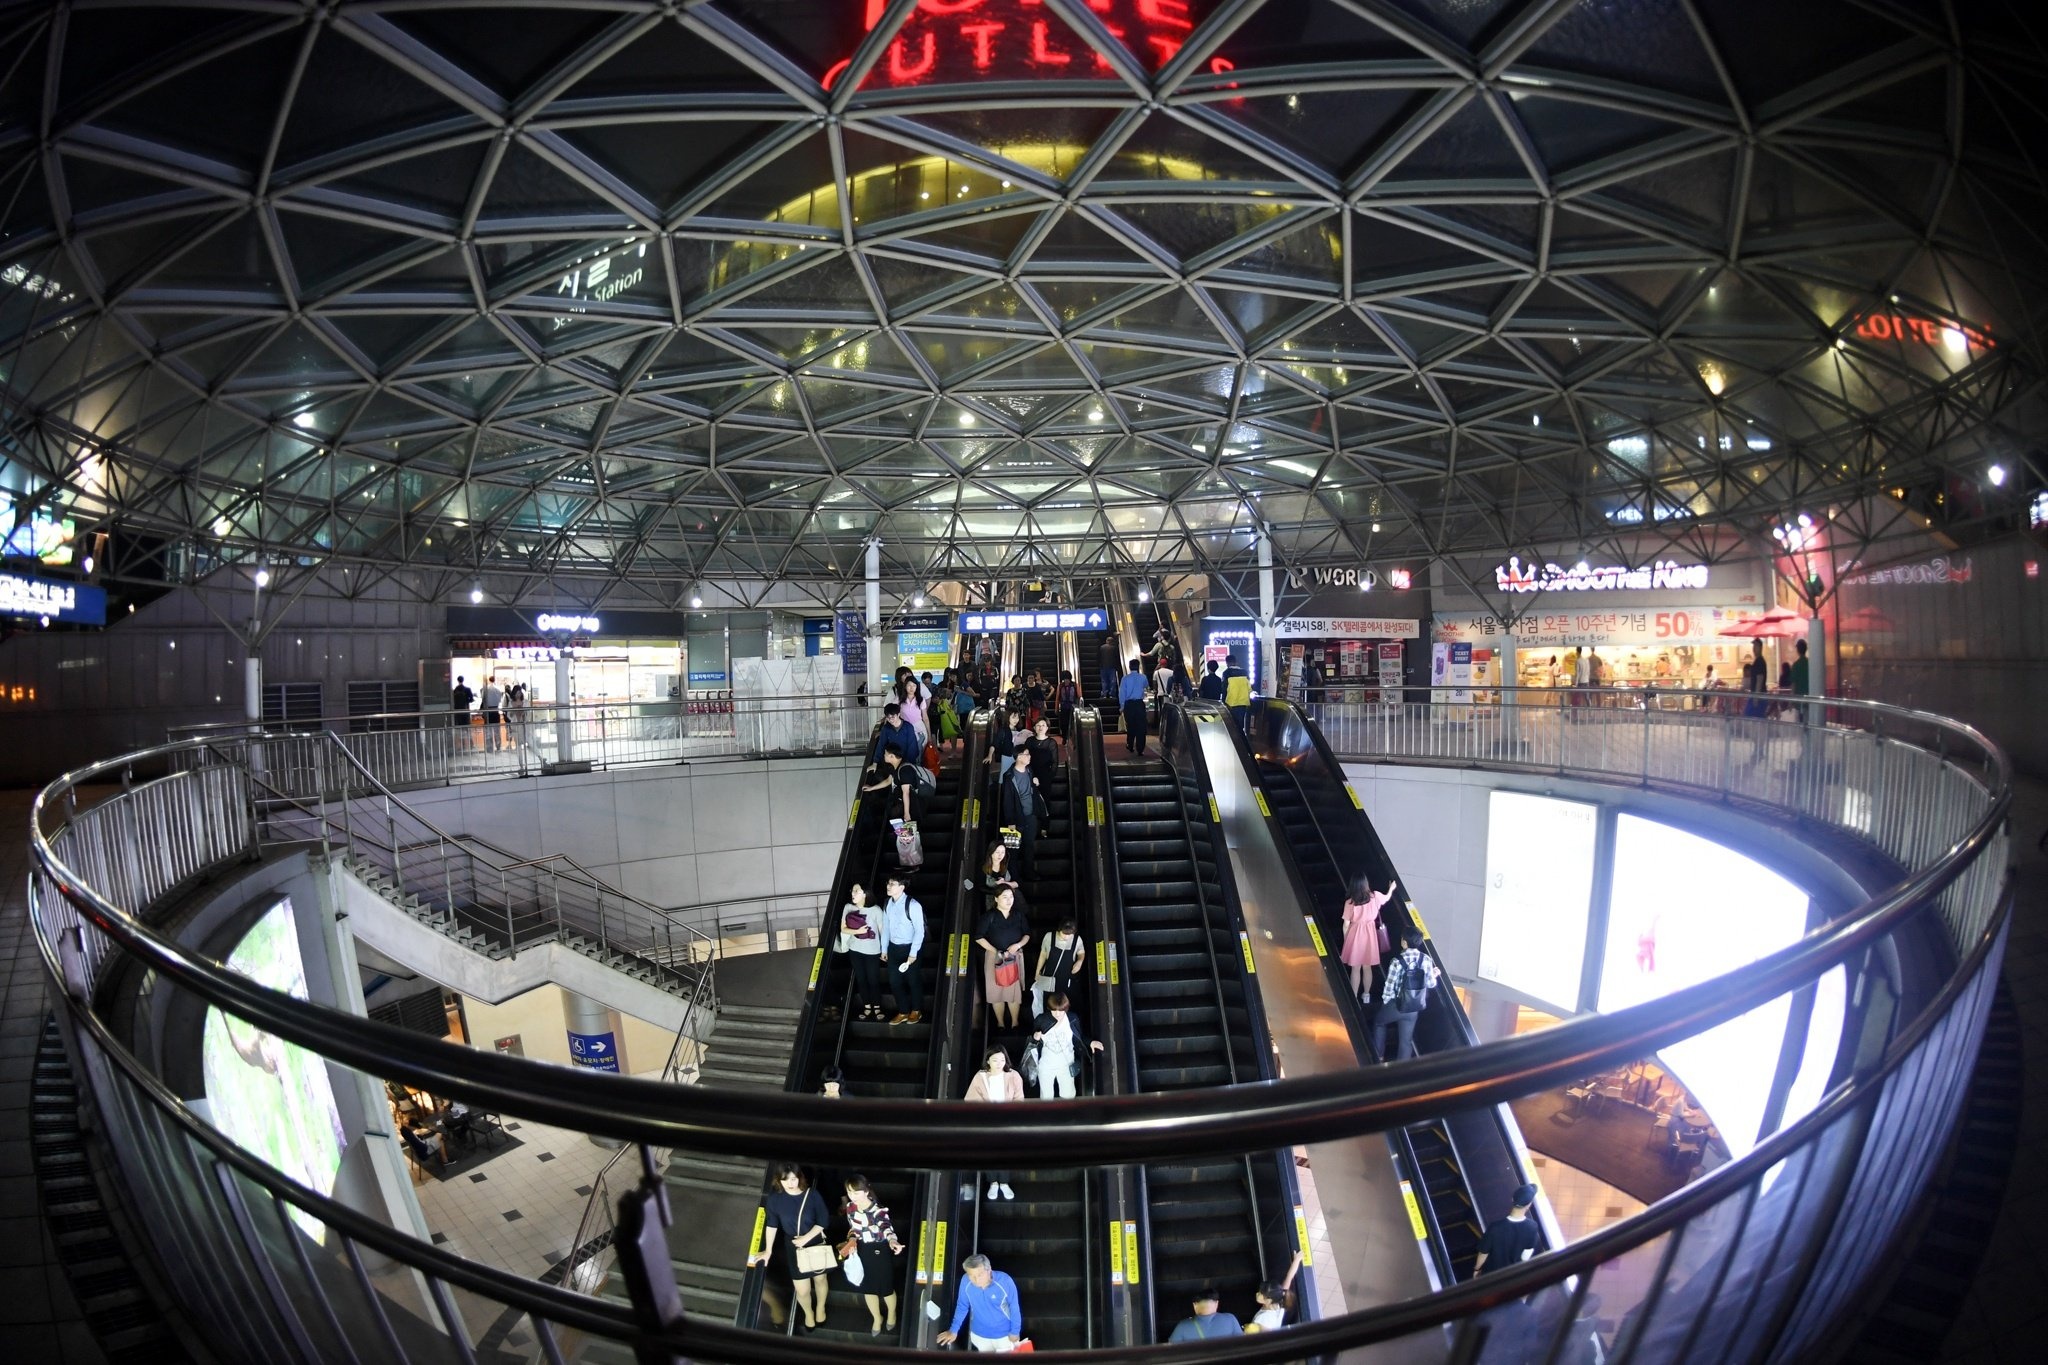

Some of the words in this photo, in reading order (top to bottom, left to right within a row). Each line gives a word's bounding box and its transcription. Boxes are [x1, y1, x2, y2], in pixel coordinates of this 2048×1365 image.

[594, 267, 643, 302] Station
[1282, 620, 1310, 633] 갤럭시
[1331, 620, 1383, 633] SK텔레콤에서
[1543, 614, 1570, 633] 오픈
[1575, 613, 1616, 632] 10주년
[1621, 613, 1647, 632] 기념
[902, 632, 943, 640] CURRENCY
